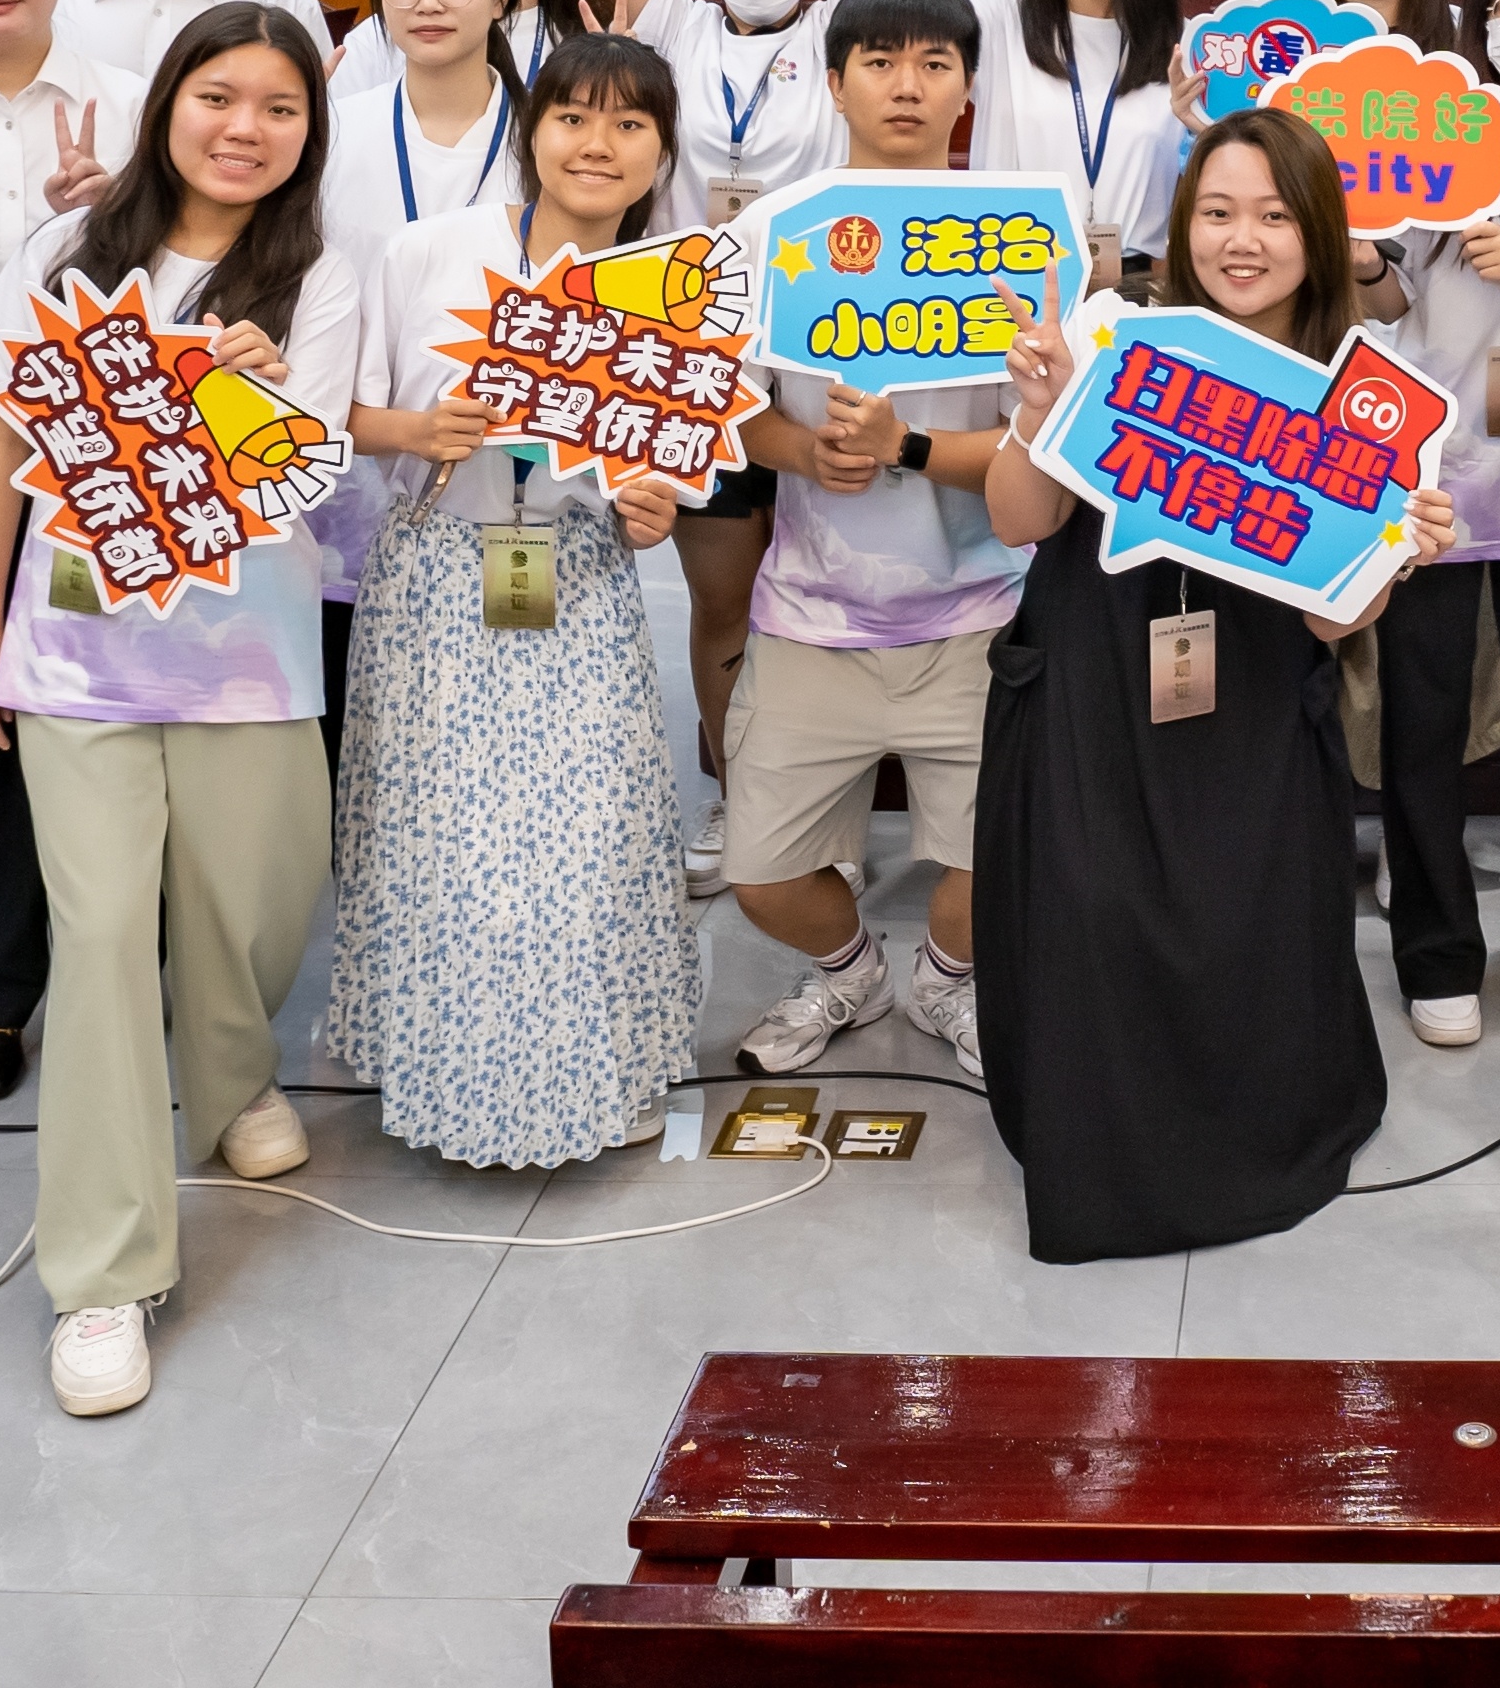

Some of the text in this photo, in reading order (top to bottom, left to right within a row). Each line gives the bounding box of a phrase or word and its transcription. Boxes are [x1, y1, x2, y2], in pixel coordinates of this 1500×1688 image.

[1201, 30, 1343, 77] 对毒
[1290, 86, 1493, 144] 法院好
[1337, 150, 1455, 204] city
[901, 211, 1055, 277] 法治
[487, 286, 743, 414] 法护未来
[807, 292, 1038, 362] 小明星
[75, 313, 249, 568] 法护未来
[467, 356, 723, 477] 守望侨都
[1104, 340, 1400, 515] 扫黑除恶
[1350, 389, 1400, 431] GO
[8, 340, 180, 592] 守望侨都
[1095, 419, 1313, 567] 不停步
